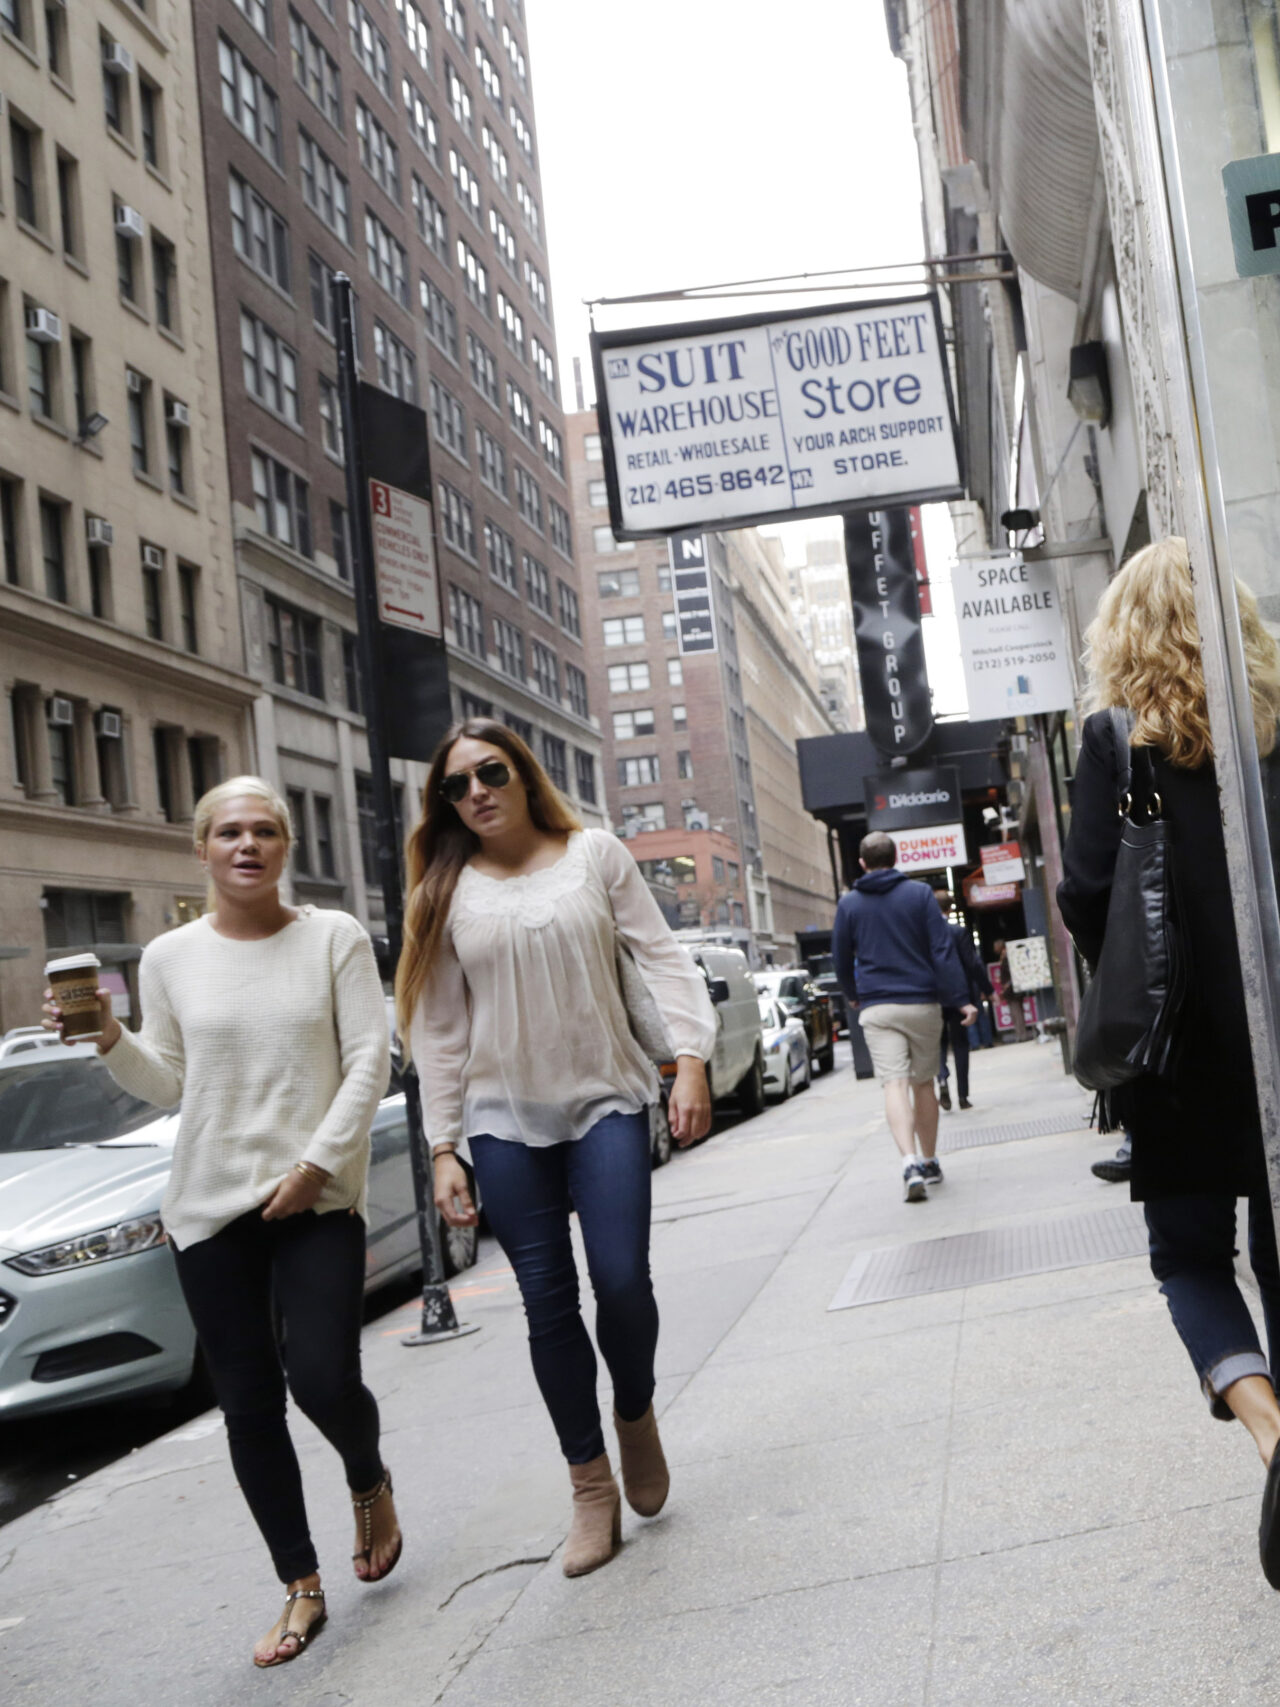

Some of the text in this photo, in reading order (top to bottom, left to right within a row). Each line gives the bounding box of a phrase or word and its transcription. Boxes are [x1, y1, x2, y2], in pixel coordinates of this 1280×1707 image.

[787, 314, 927, 371] GOOD FEET
[637, 341, 746, 394] SUIT
[801, 374, 921, 419] Store
[616, 389, 778, 438] WAREHOUSE
[793, 416, 945, 453] YOUR ARCH SUPPORT
[834, 450, 909, 475] STORE.
[376, 486, 387, 513] 3
[624, 479, 662, 506] (212)
[664, 465, 785, 498] 465-8642
[376, 521, 421, 548] COMMERCIAL
[377, 536, 429, 564] VEHICLES ONLY
[978, 565, 1029, 587] SPACE
[962, 591, 1053, 619] AVAILABLE
[973, 650, 1056, 672] (212) 519-2050
[883, 631, 906, 744] GROUP
[901, 847, 957, 864] DONUTS
